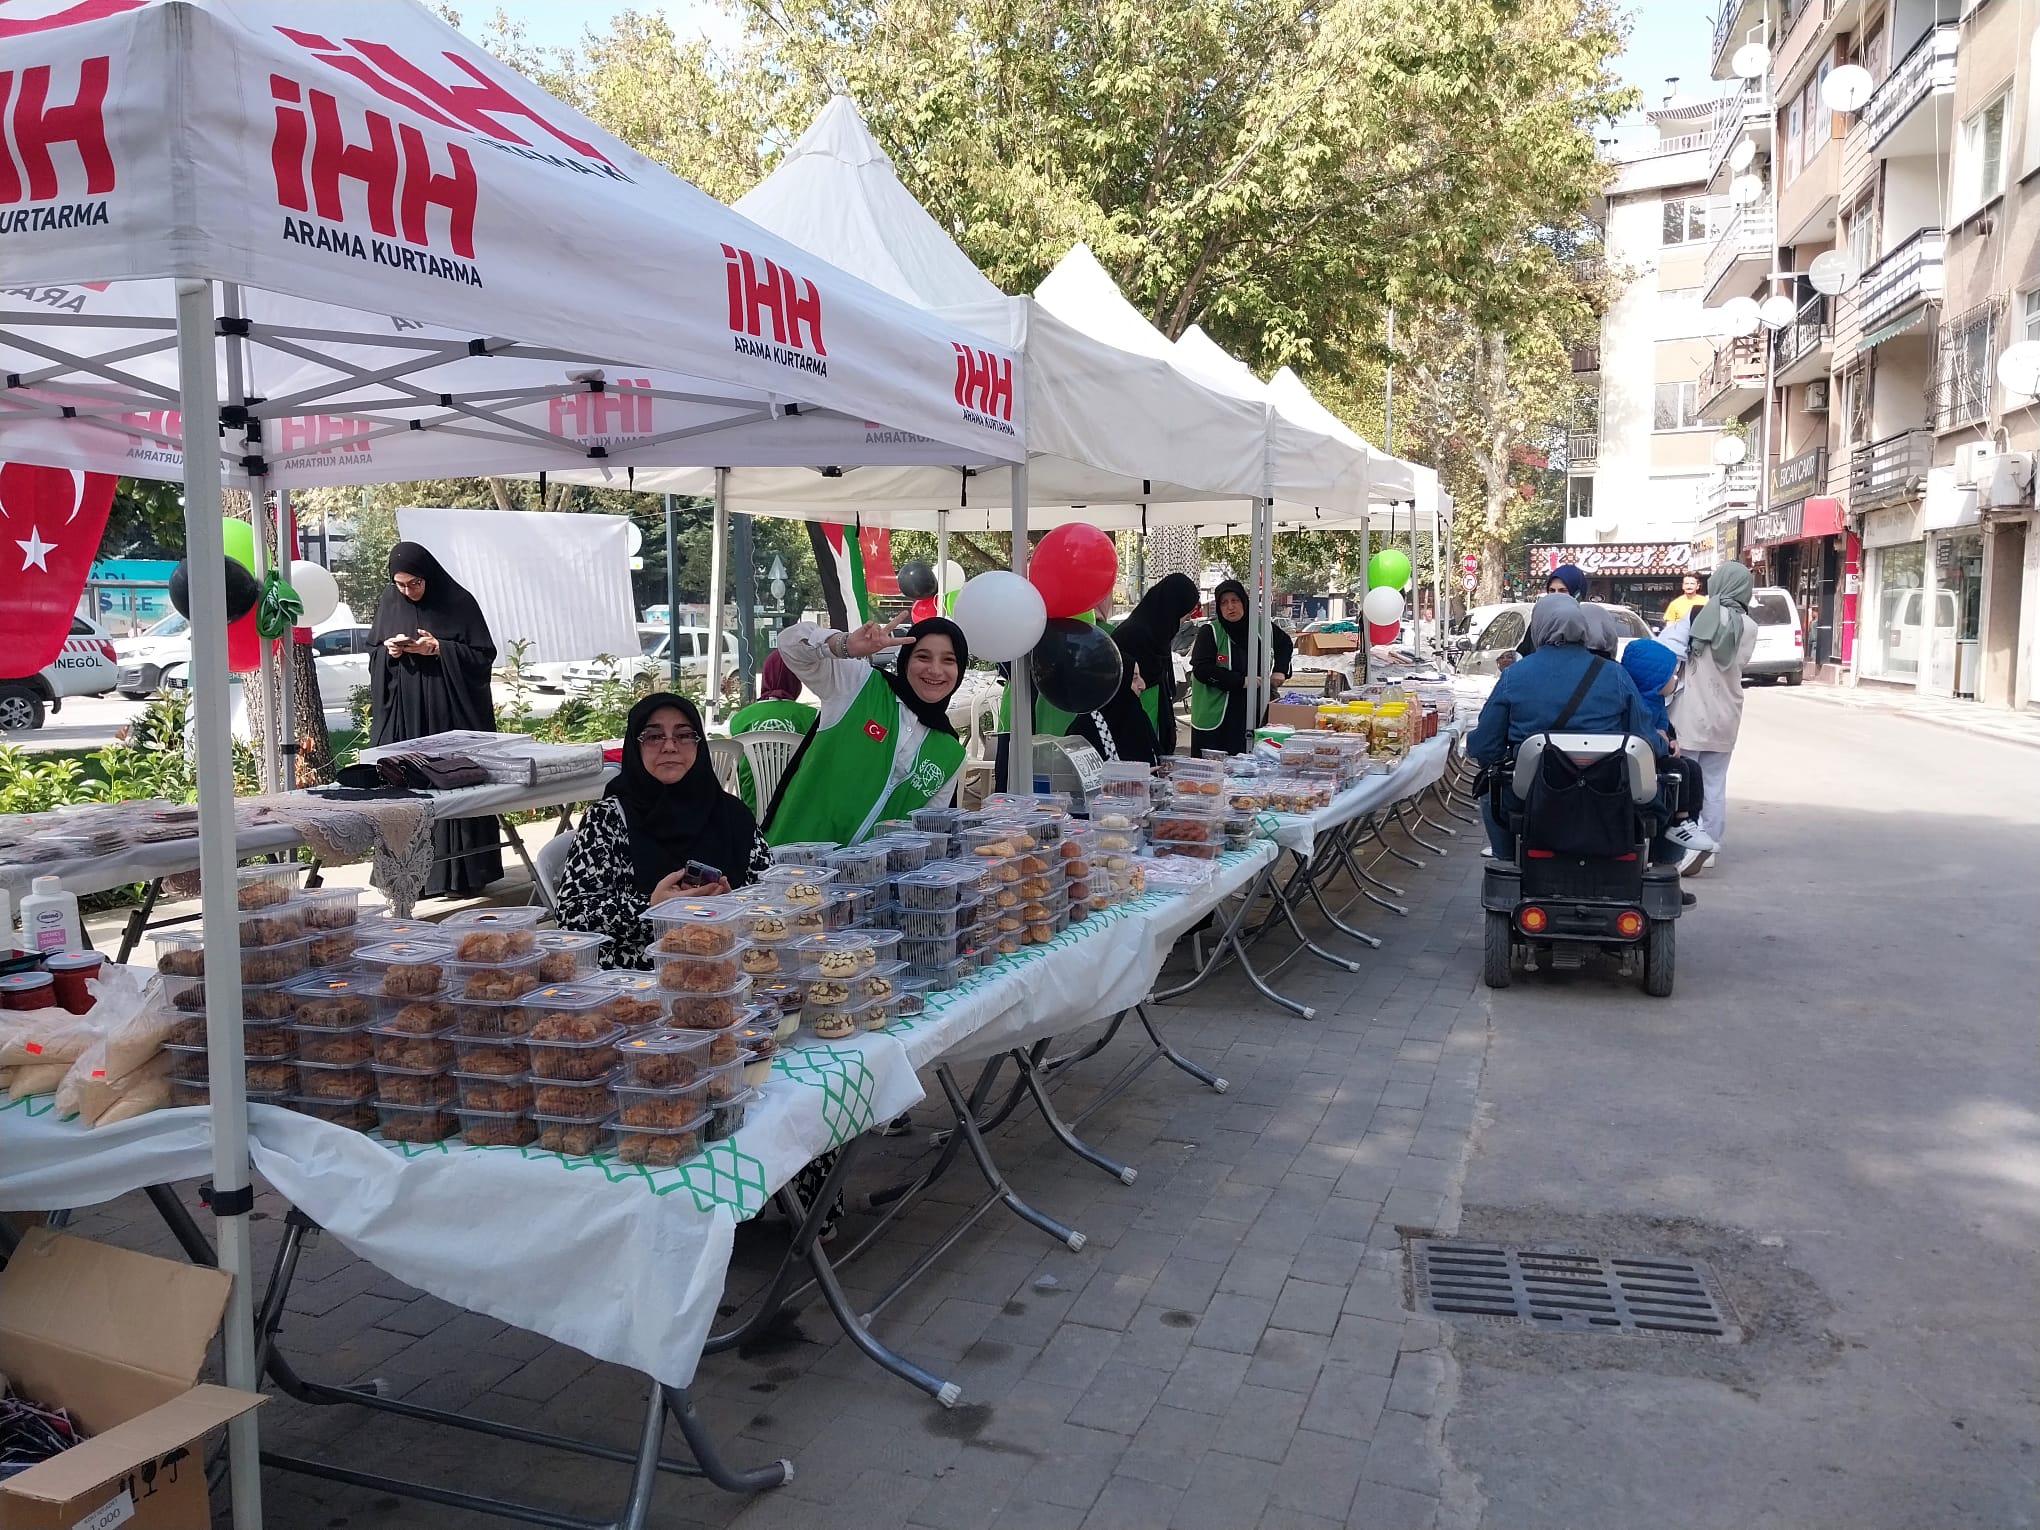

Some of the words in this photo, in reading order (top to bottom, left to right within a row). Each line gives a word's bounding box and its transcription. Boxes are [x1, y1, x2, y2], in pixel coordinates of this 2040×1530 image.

[0, 201, 109, 233] URTARMA
[283, 216, 366, 260] ARAMA
[371, 240, 483, 288] KURTARMA
[734, 336, 772, 362] ARAMA
[773, 346, 827, 378] KURTARMA
[963, 408, 984, 426] ARAMA
[1576, 546, 1657, 573] Lezzet
